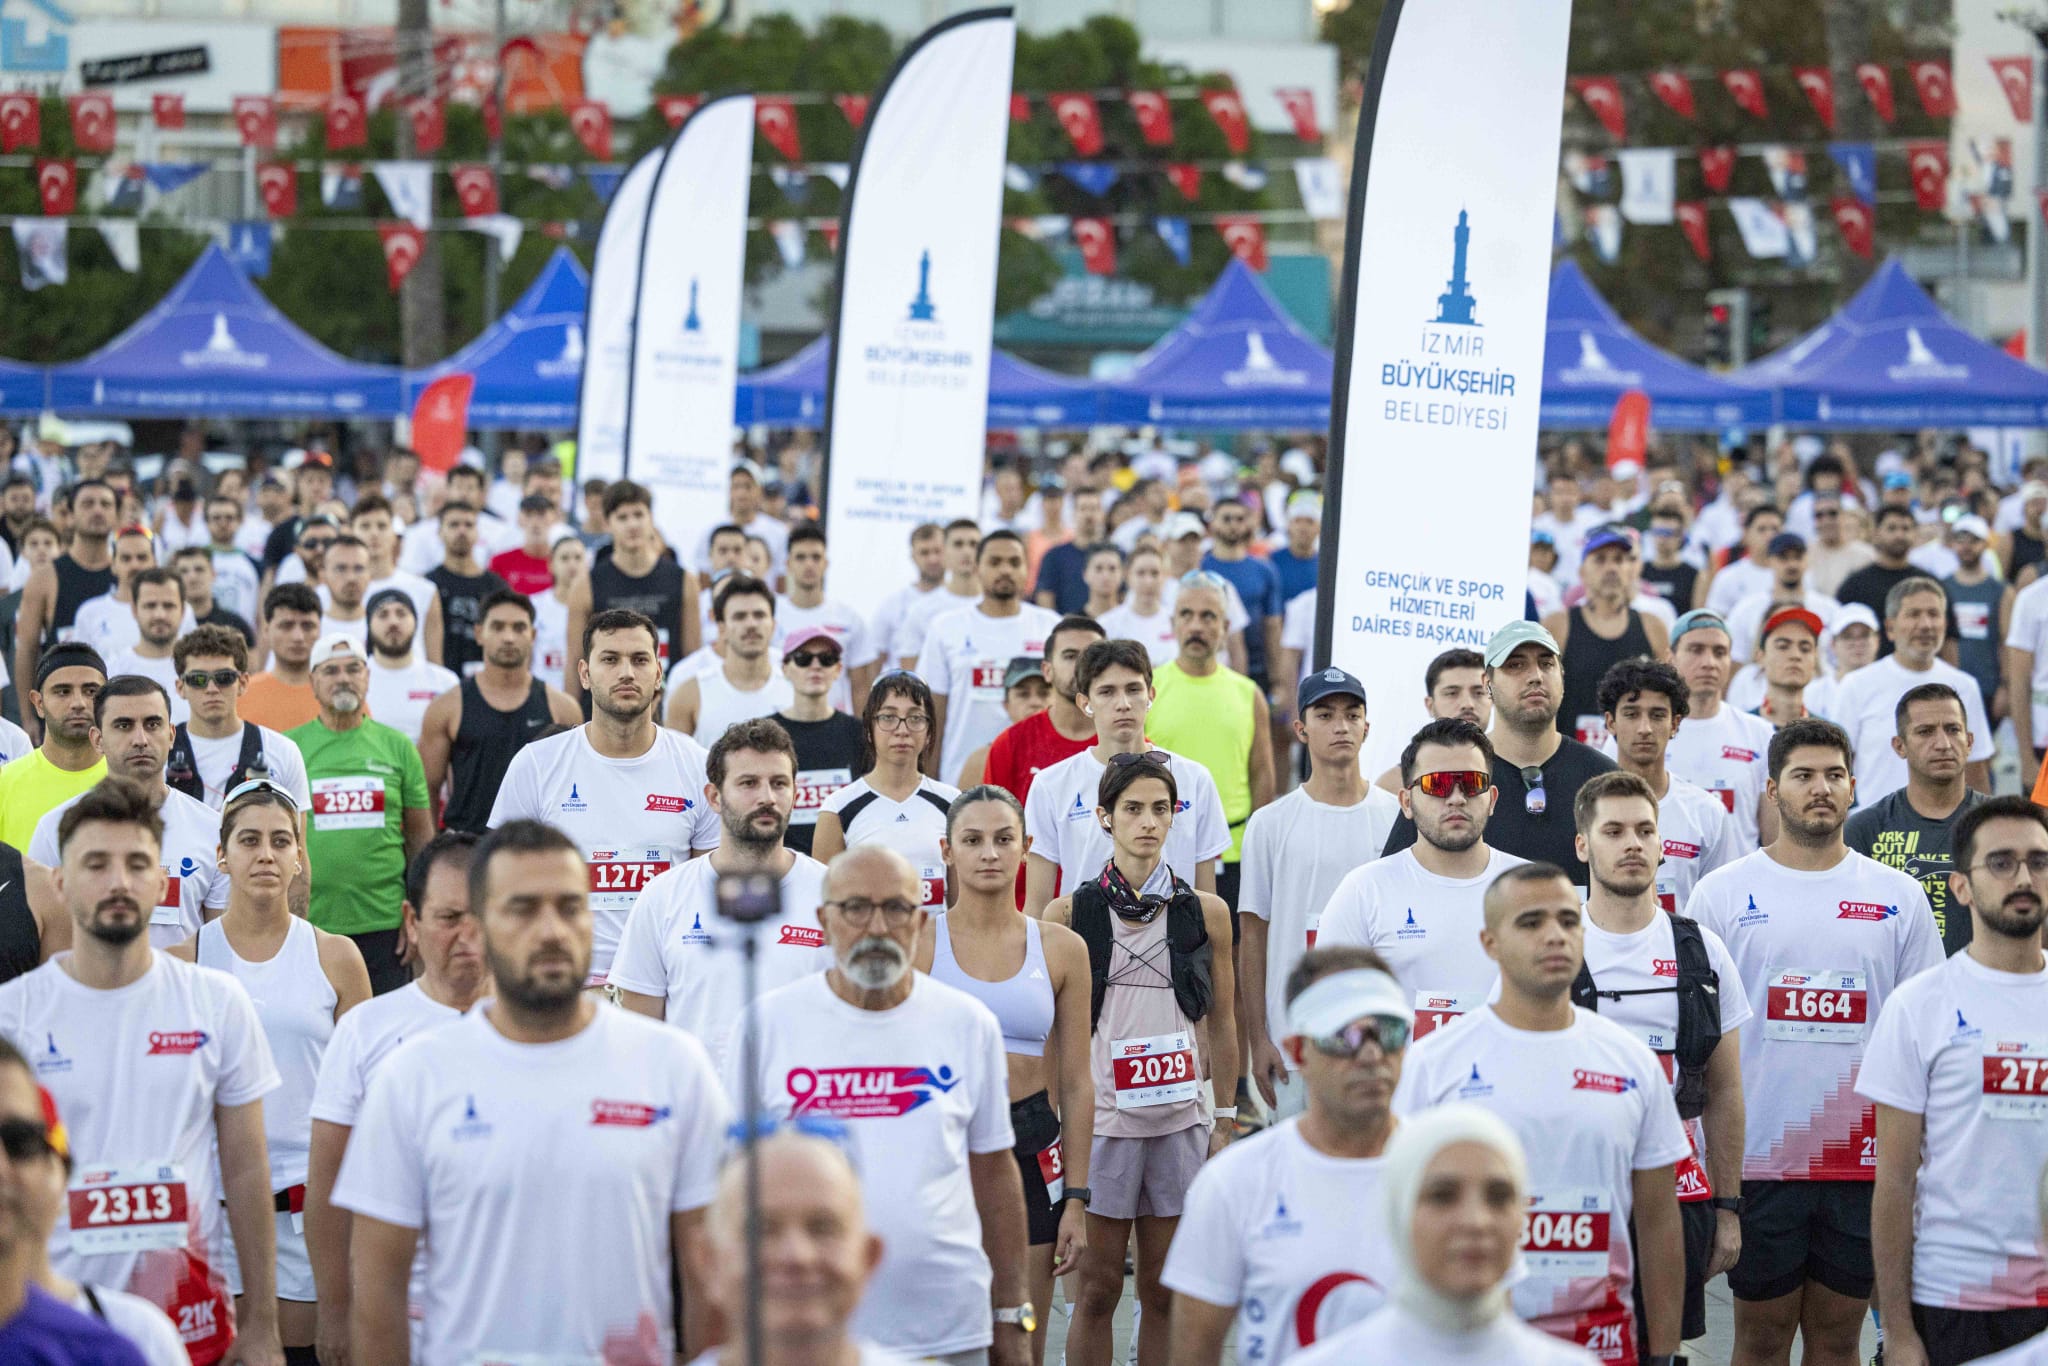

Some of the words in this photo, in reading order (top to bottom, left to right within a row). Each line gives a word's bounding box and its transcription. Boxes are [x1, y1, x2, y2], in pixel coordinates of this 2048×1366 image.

[1421, 327, 1484, 357] İZMİR
[1381, 359, 1515, 396] BÜYÜKŞEHİR
[1384, 400, 1508, 430] BELEDİYESİ
[1365, 570, 1431, 595] GENÇLİK
[1435, 578, 1453, 595] VE
[1458, 580, 1504, 600] SPOR
[1390, 593, 1475, 621] HİZMETLERİ
[1416, 622, 1494, 646] BAŞKANL
[324, 791, 374, 812] 2926
[1872, 842, 1905, 854] OUT
[596, 864, 656, 888] 1275
[1841, 977, 1855, 985] 21K
[1784, 990, 1852, 1019] 1664
[1648, 1035, 1663, 1043] 21K
[1128, 1053, 1186, 1084] 2029
[1861, 1136, 1877, 1156] 21
[87, 1184, 172, 1224] 2313
[178, 1300, 217, 1331] 21K
[1585, 1322, 1623, 1349] 21K
